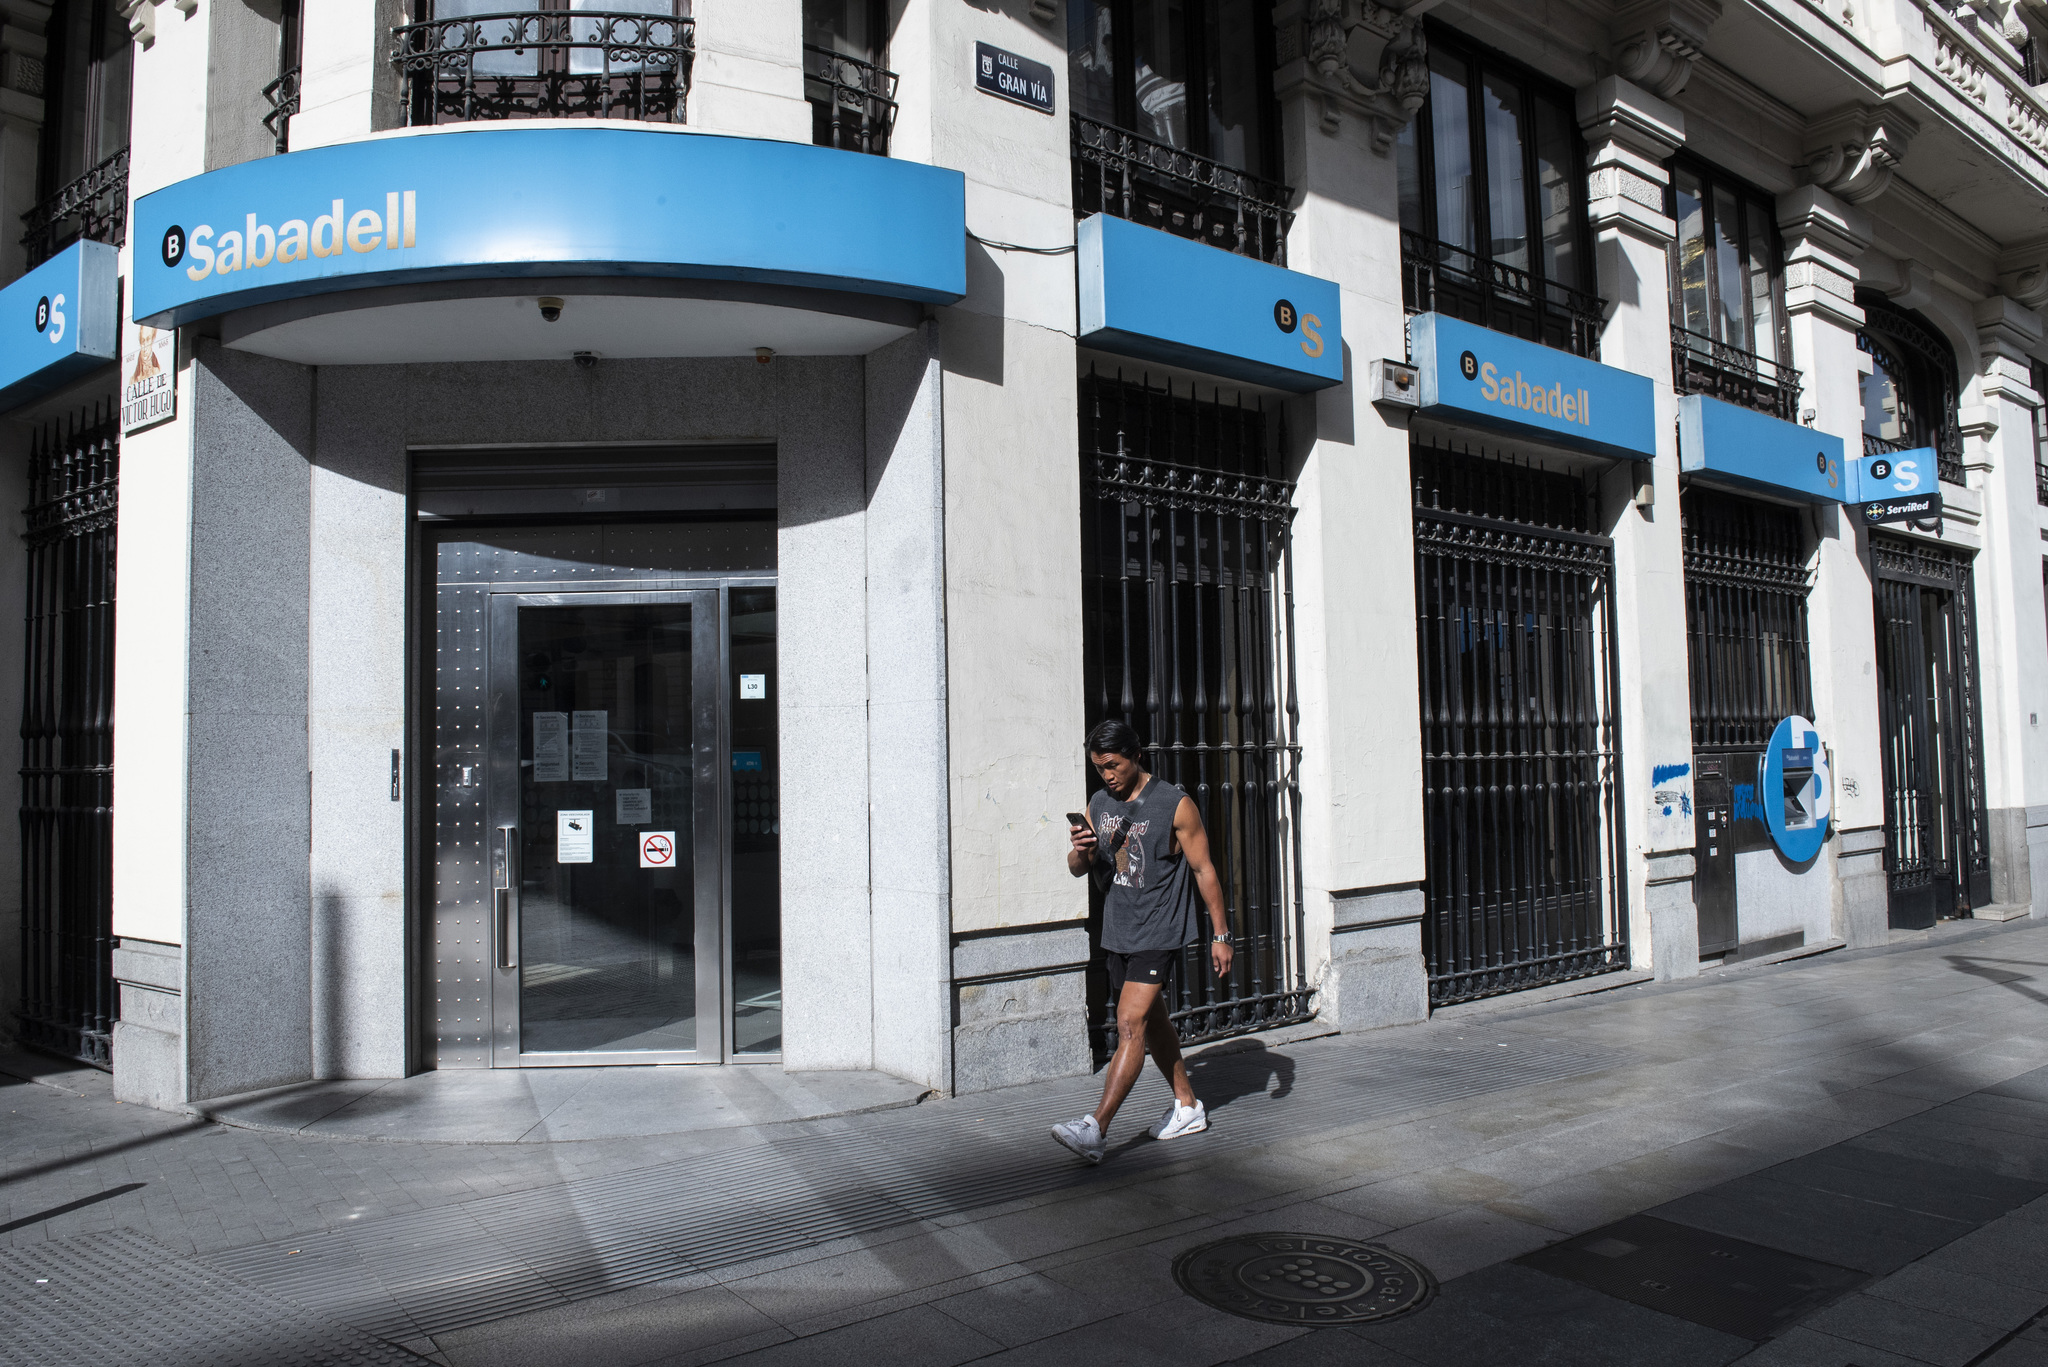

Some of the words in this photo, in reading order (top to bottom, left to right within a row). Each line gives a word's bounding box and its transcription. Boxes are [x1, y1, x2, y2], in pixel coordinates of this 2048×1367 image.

[998, 53, 1019, 70] CALLE
[998, 71, 1027, 96] GRAN
[1031, 80, 1047, 102] VÍA
[186, 190, 416, 282] Sabadell
[126, 376, 154, 402] CALLE
[157, 373, 167, 388] DE
[1481, 361, 1590, 426] Sabadell
[121, 398, 148, 426] VICTOR
[149, 389, 172, 418] HUGO
[1886, 501, 1930, 515] ServiRed
[1099, 811, 1124, 832] Pink
